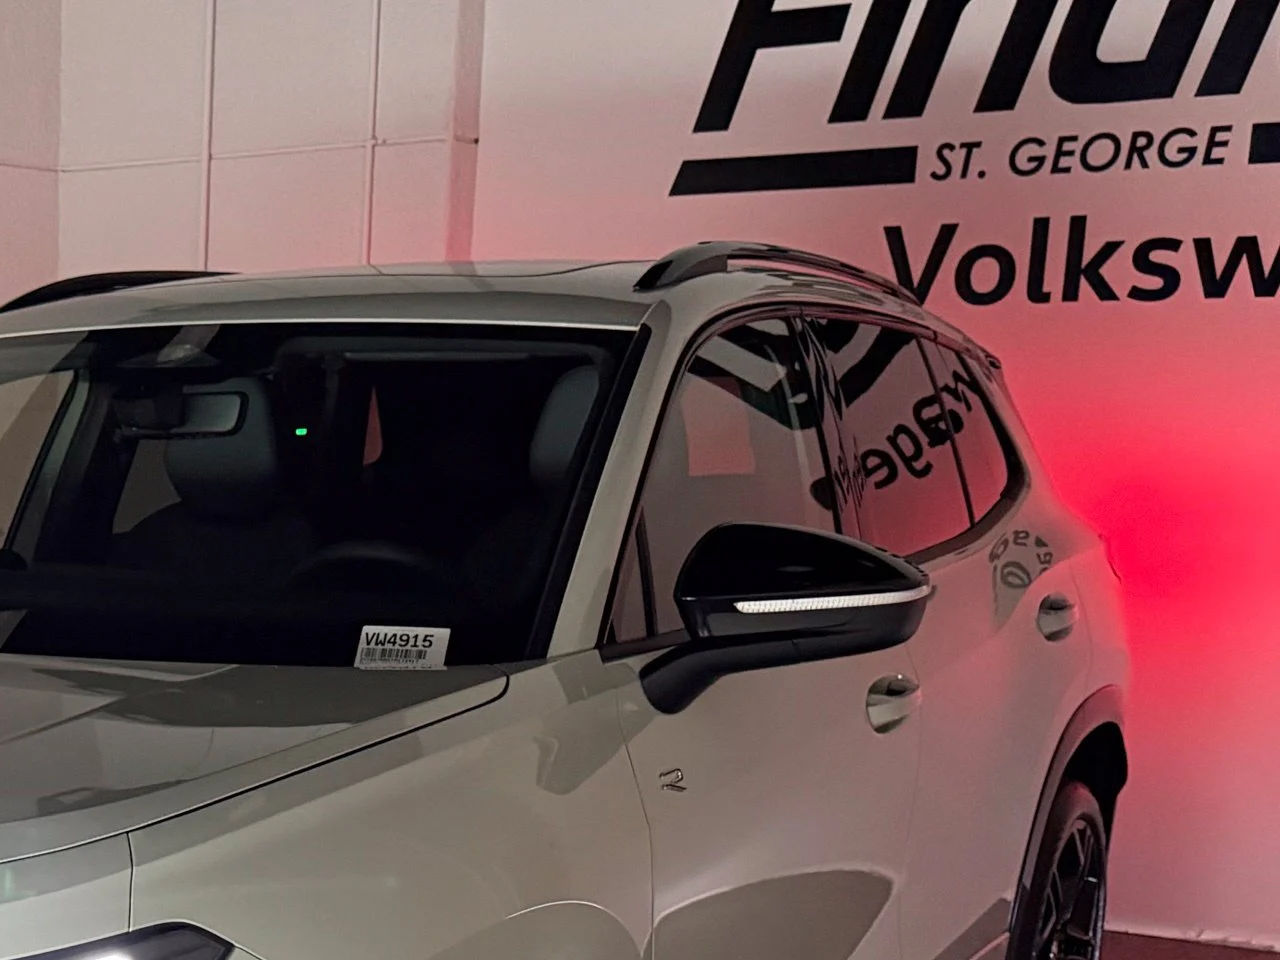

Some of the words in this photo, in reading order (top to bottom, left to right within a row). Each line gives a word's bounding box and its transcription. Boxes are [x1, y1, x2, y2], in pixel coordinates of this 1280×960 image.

[930, 141, 988, 182] ST.
[1008, 125, 1233, 178] GEORGE
[365, 632, 434, 648] VW4915
